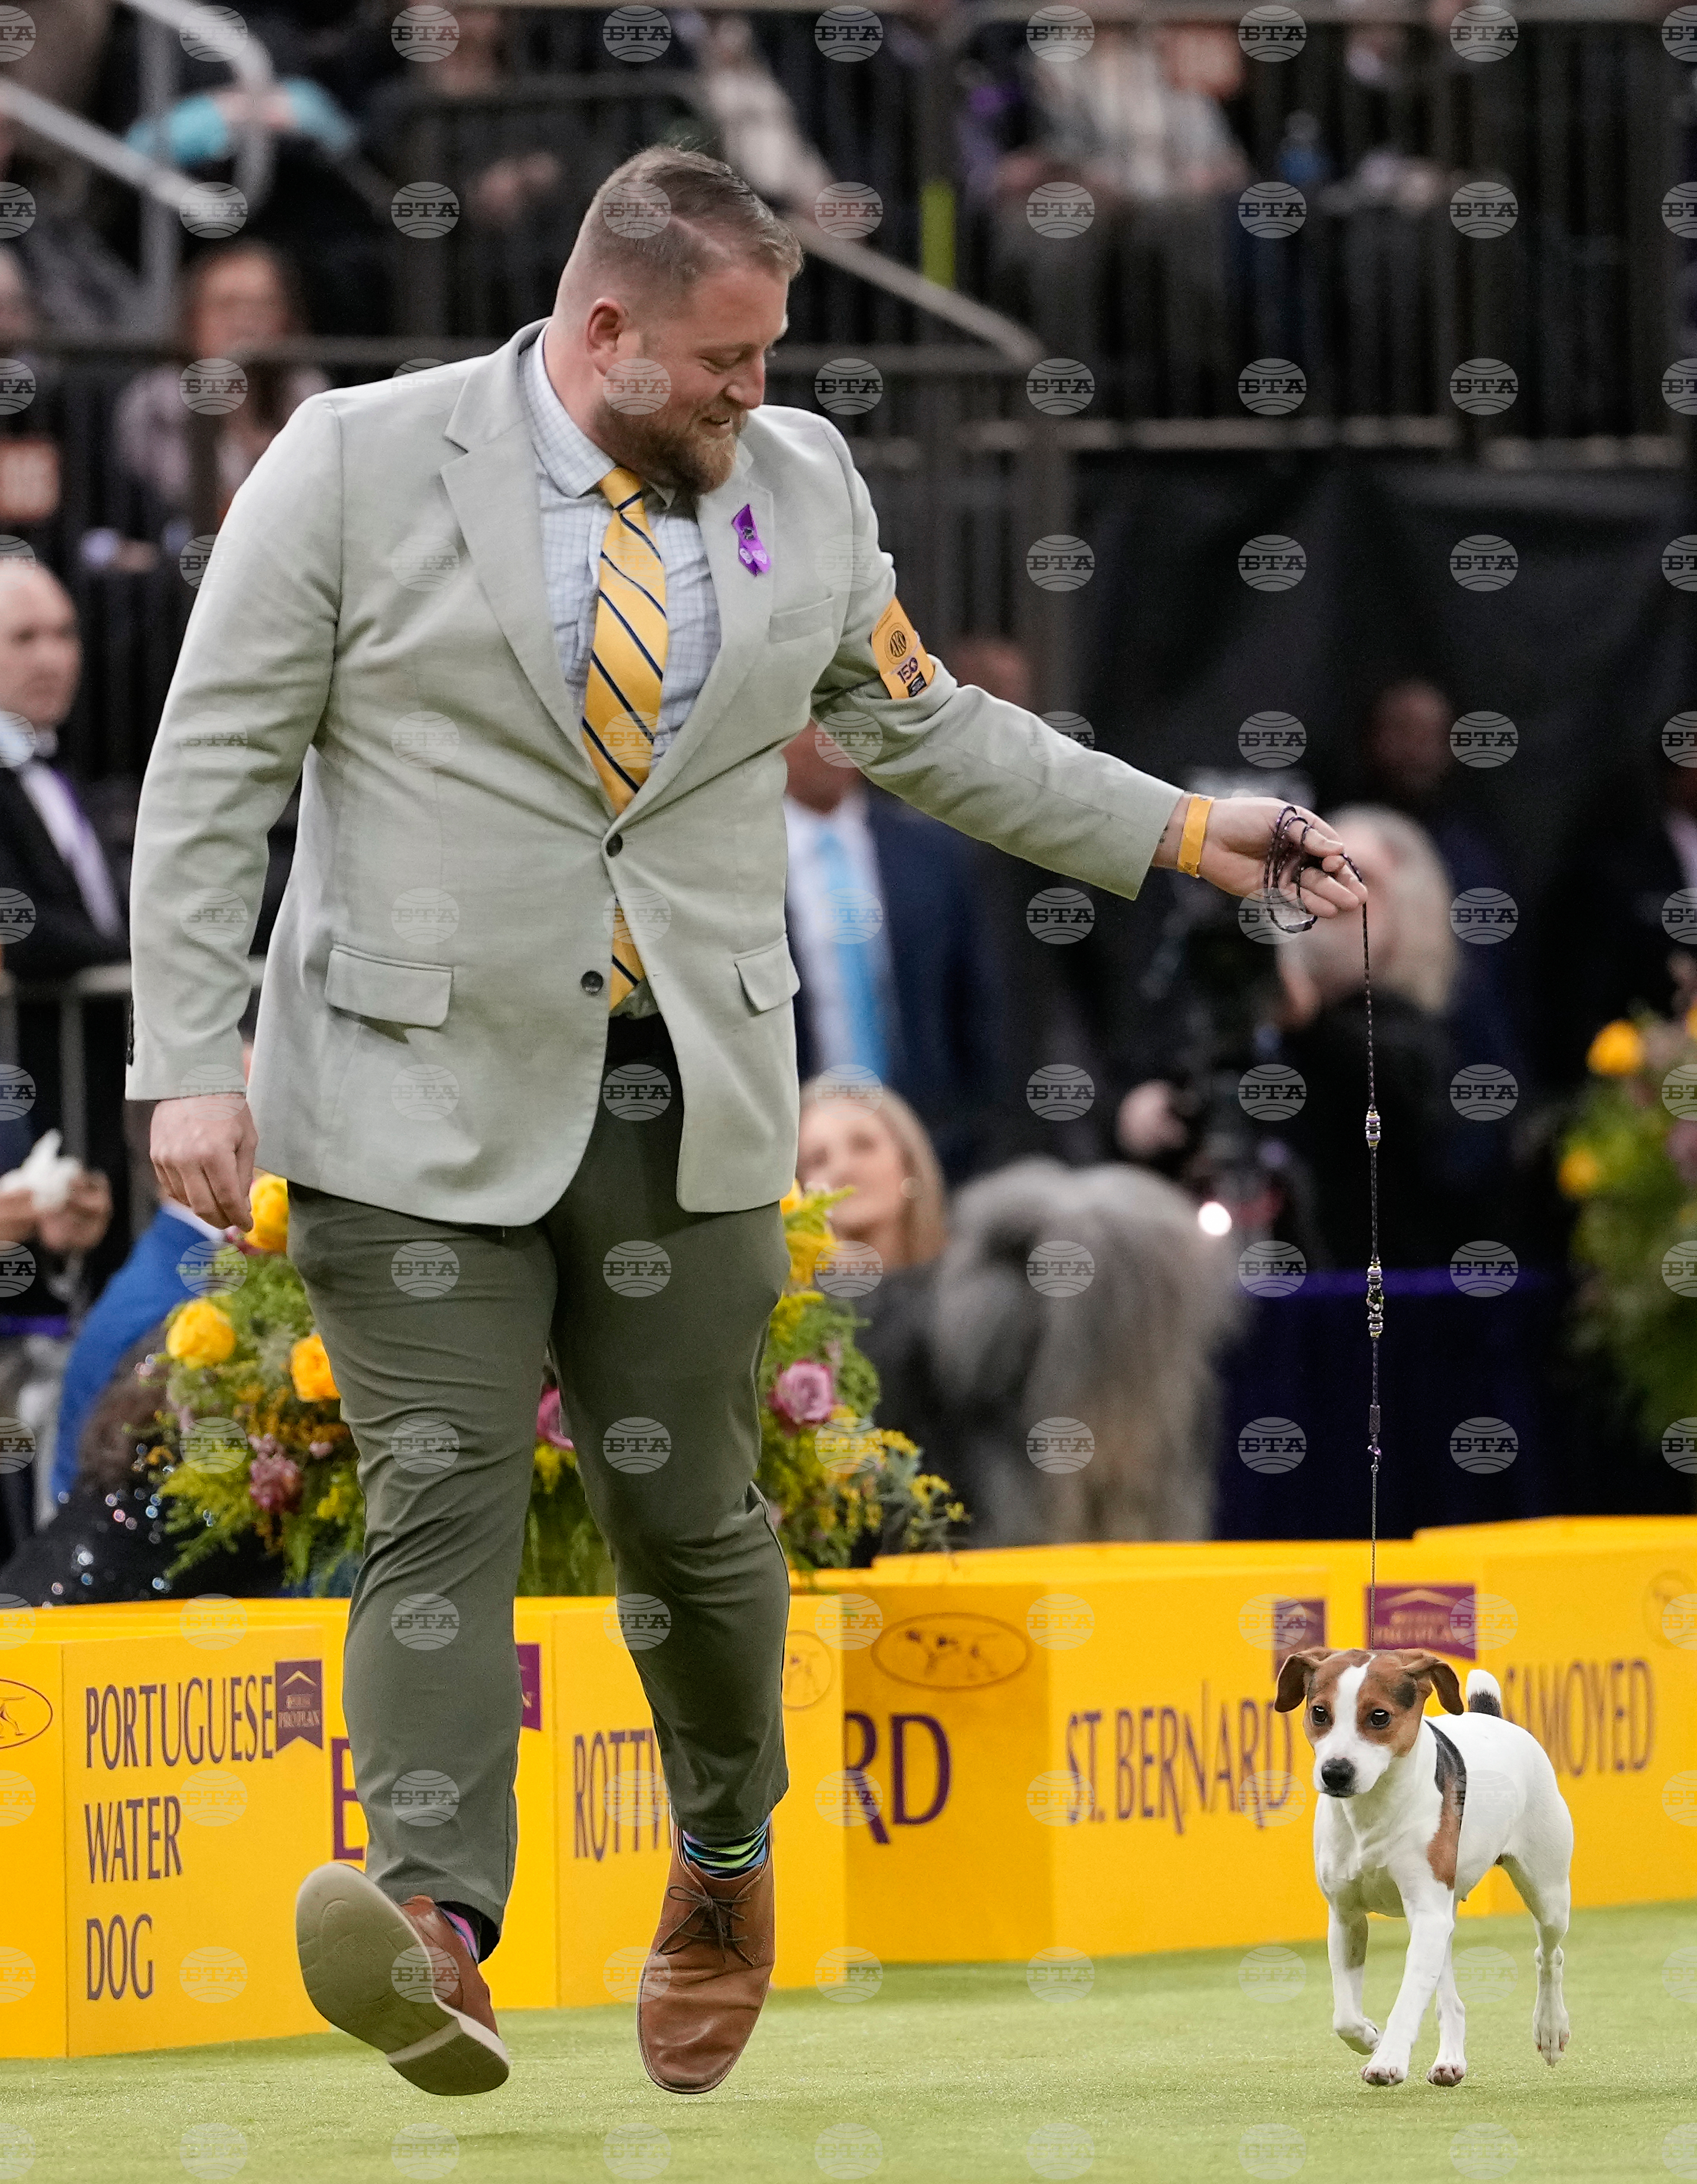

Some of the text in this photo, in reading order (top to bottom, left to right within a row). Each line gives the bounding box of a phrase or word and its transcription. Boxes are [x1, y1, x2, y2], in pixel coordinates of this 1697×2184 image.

[86, 1675, 274, 1770] PORTUGUESE
[1065, 1678, 1294, 1835] ST. BERNARD
[85, 1795, 182, 1883] WATER
[86, 1913, 153, 2000] DOG
